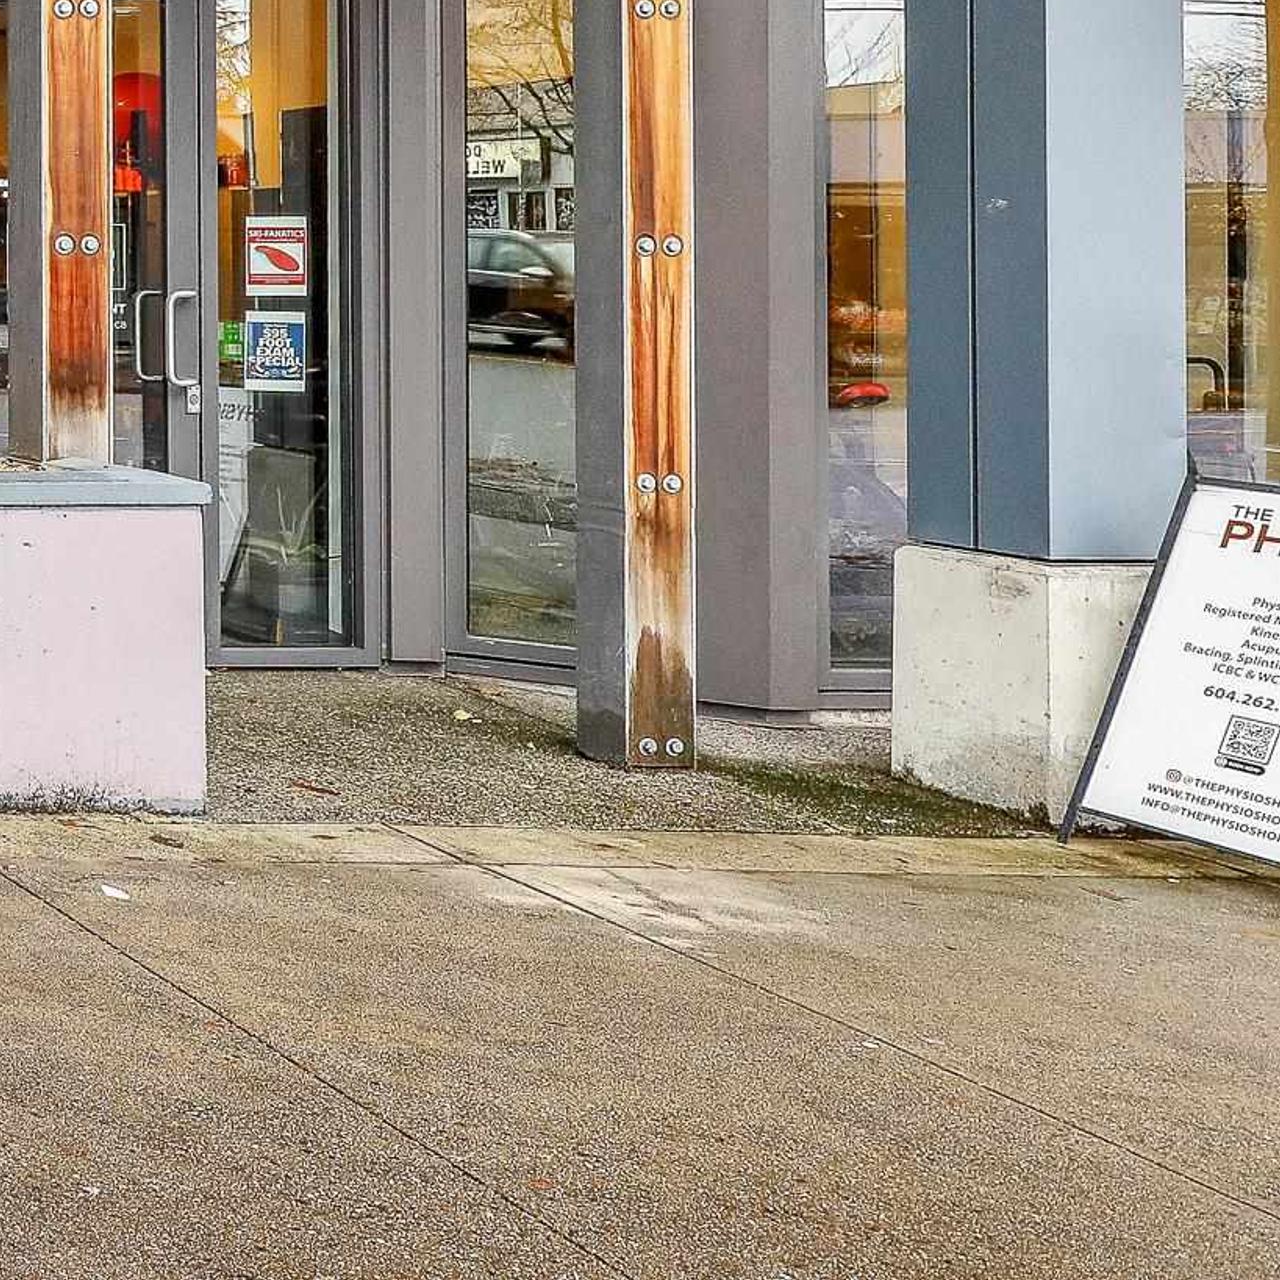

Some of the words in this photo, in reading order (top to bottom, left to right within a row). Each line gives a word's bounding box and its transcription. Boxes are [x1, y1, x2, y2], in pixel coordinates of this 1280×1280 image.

[258, 338, 292, 347] FOOT
[256, 347, 295, 357] EXAM
[249, 356, 303, 367] SPECIAL
[1232, 504, 1275, 521] THE
[1203, 603, 1272, 624] Registered
[1213, 663, 1245, 678] ICBC
